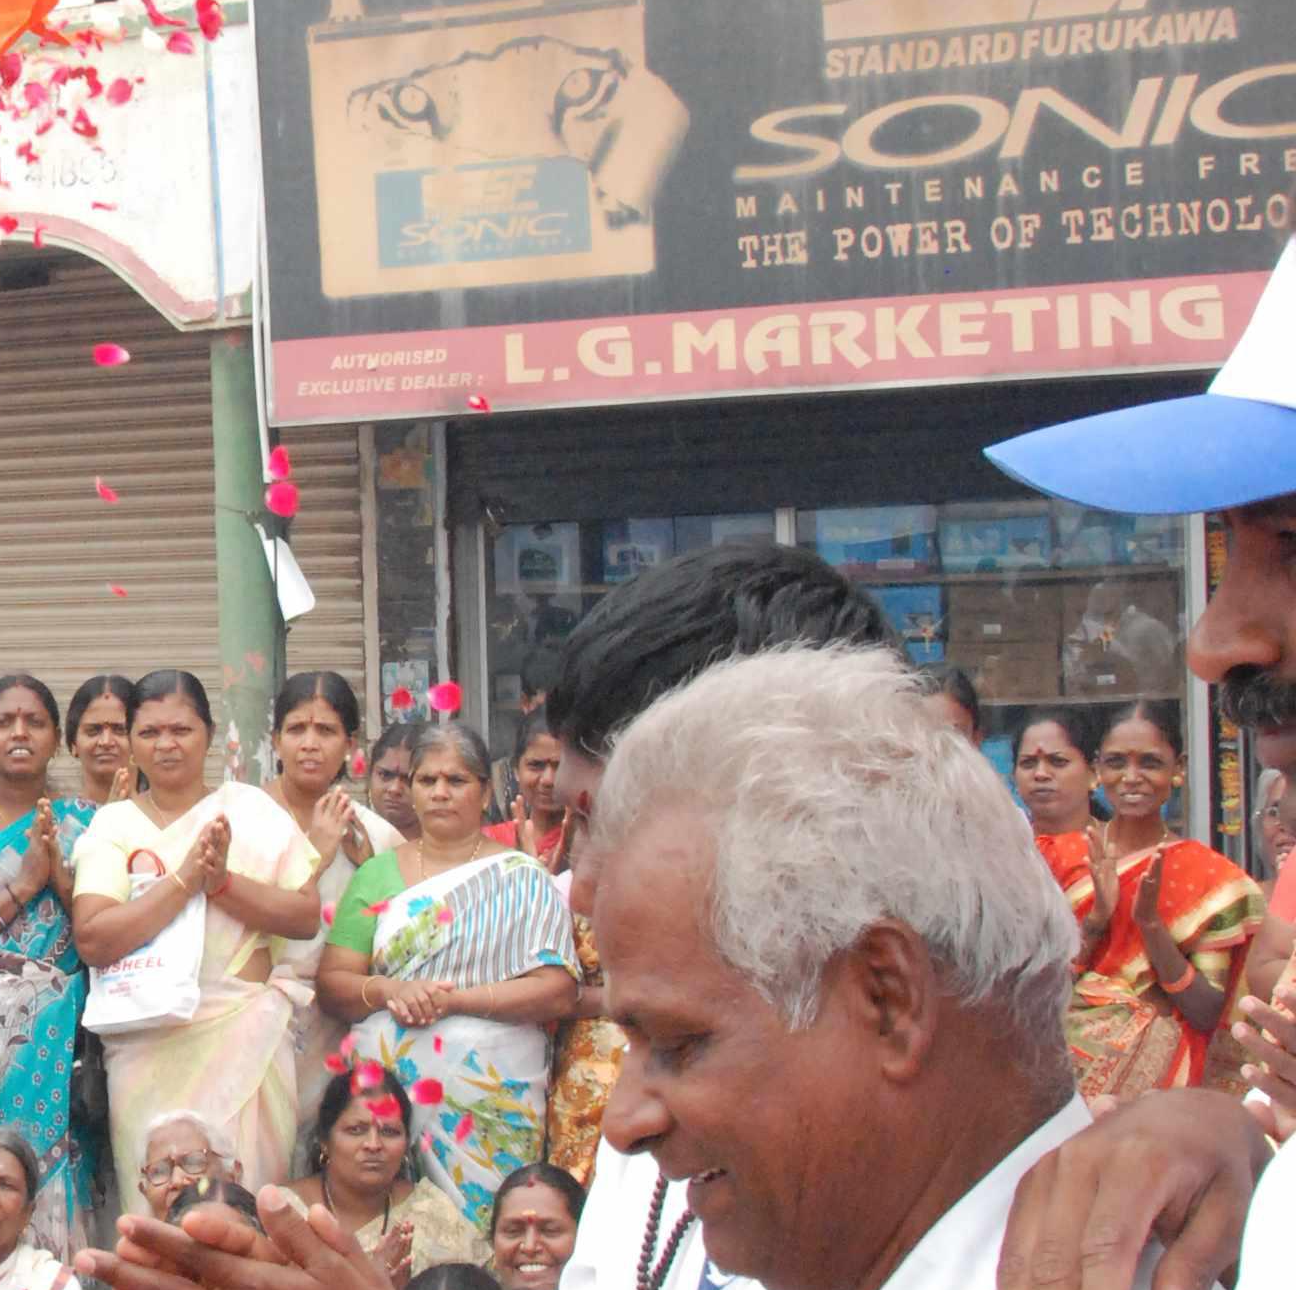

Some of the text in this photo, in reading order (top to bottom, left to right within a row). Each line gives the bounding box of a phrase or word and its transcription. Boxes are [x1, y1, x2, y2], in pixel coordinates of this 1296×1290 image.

[824, 7, 1238, 79] STANDARD FURUKAWA
[733, 60, 1296, 179] SONIC
[734, 161, 1144, 219] MAINTENANCE
[737, 229, 809, 268] THE
[835, 220, 974, 262] POWER
[989, 215, 1042, 252] OF
[297, 377, 398, 396] EXCLUSIVE
[401, 373, 472, 391] DEALER
[330, 349, 448, 370] AUTHORISED
